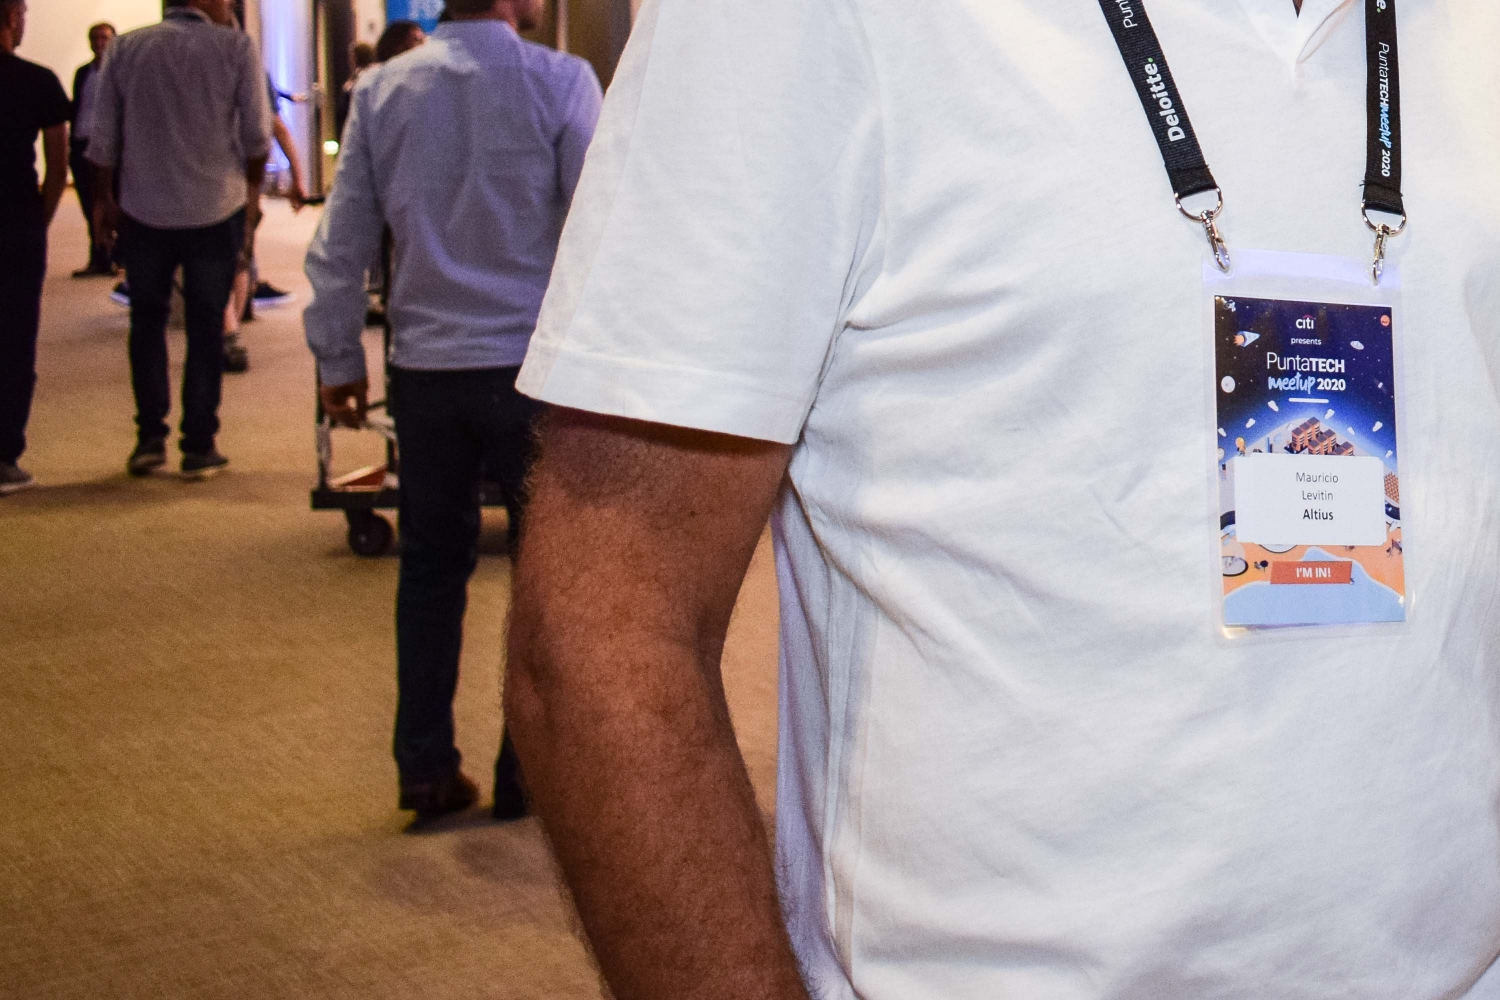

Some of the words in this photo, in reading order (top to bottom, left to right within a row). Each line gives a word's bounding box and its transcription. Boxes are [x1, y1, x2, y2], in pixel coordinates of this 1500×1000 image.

[1381, 149, 1391, 177] 2020
[1295, 316, 1315, 329] citi
[1290, 337, 1322, 346] presents
[1266, 352, 1345, 373] PuntaTECH
[1316, 378, 1346, 391] 2020
[1295, 472, 1339, 483] Mauricio
[1302, 490, 1334, 501] Levitin
[1303, 509, 1334, 521] Altius
[1296, 567, 1312, 578] I'M
[1315, 567, 1331, 578] IN!
